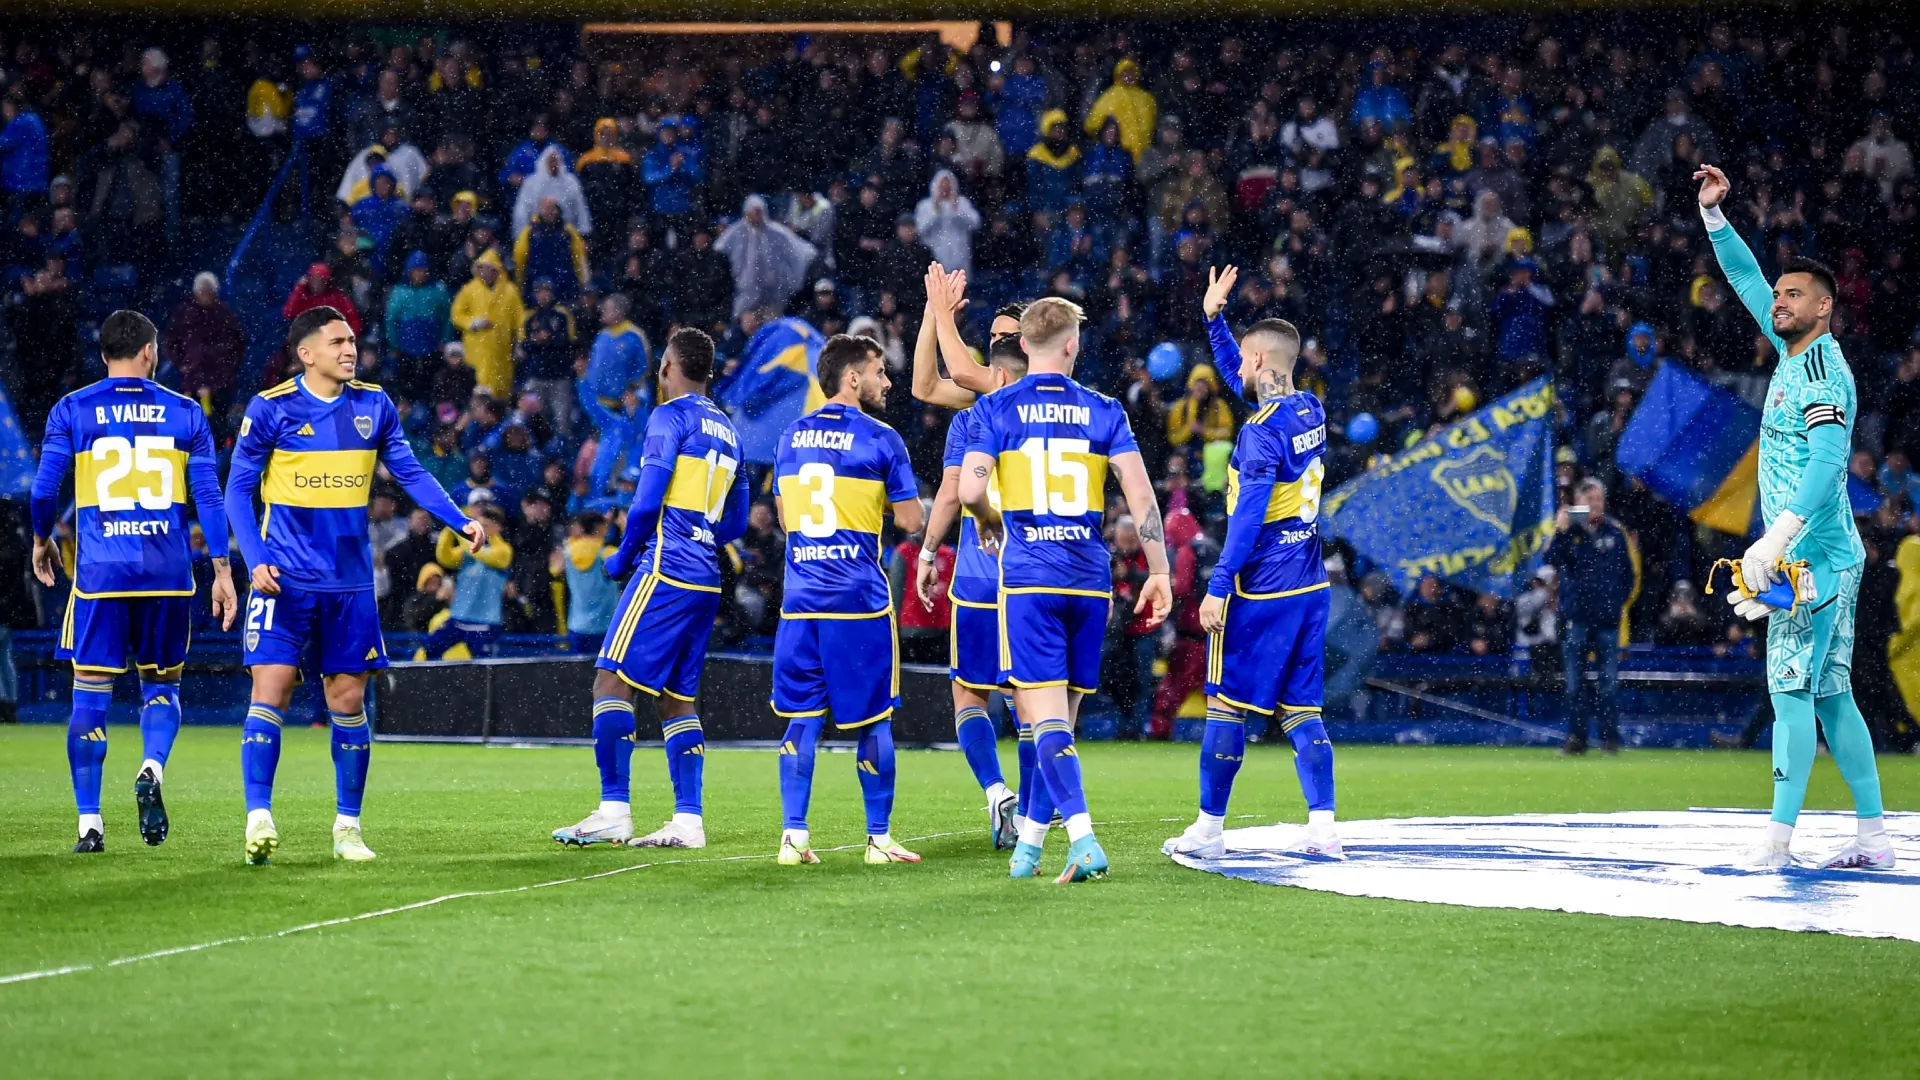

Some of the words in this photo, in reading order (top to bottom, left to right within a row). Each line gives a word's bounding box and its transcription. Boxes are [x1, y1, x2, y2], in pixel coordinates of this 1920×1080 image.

[95, 406, 110, 425] B.
[112, 404, 166, 423] VALDEZ
[1016, 404, 1090, 426] VALENTINI
[791, 429, 855, 451] SARACCHI
[1291, 423, 1327, 455] BENEDETT
[92, 436, 176, 511] 25
[704, 448, 738, 525] 17
[1020, 437, 1091, 516] 15
[798, 462, 838, 538] 3
[1299, 457, 1325, 524] 9
[103, 520, 169, 538] DIRECTV
[1024, 525, 1091, 543] DIRECTV
[1278, 523, 1317, 545] DIRECT
[793, 545, 860, 564] DIRECTV
[247, 599, 275, 631] 21
